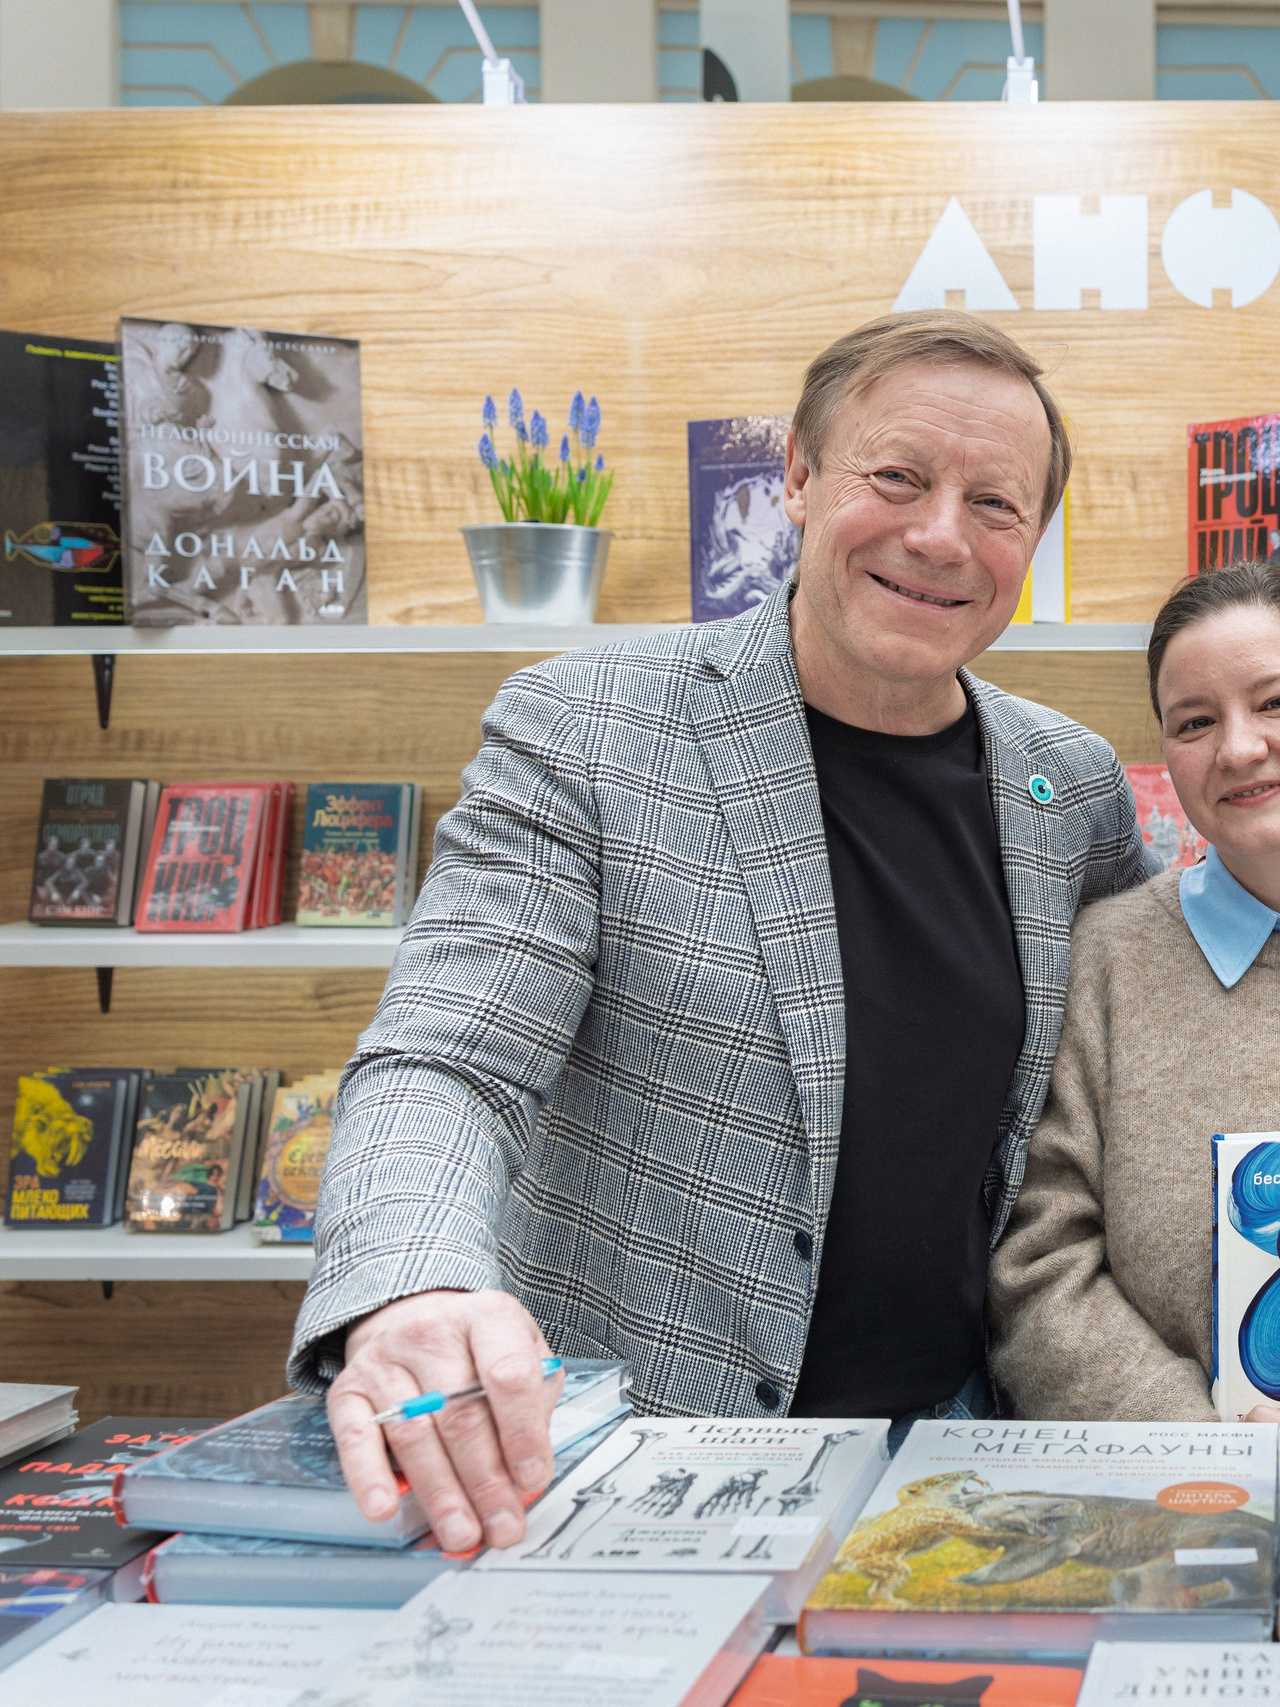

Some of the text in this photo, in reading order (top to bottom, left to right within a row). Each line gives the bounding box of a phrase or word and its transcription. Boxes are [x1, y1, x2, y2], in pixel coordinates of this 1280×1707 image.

[140, 424, 341, 451] ПЕЛОПОННЕССКАЯ
[141, 449, 346, 500] ВОЙНА
[144, 532, 346, 563] ДОНАЛЬД
[147, 564, 346, 594] КАГАН
[325, 794, 385, 814] Эффект
[312, 809, 394, 832] Люцифера
[163, 797, 251, 867] ТРОЦ
[14, 1174, 40, 1190] ЭРА
[12, 1189, 60, 1204] МЛЕКО
[10, 1203, 90, 1220] ПИТАЮЩИХ
[687, 1424, 818, 1436] Первые
[941, 1427, 1088, 1442] КОНЕЦ
[105, 1434, 196, 1444] ЗАГА
[973, 1442, 1253, 1456] МЕГАФАУНЫ
[19, 1461, 127, 1474] ПАДА
[4, 1493, 114, 1507] КОШК
[1175, 1492, 1233, 1500] ПИТЕРА
